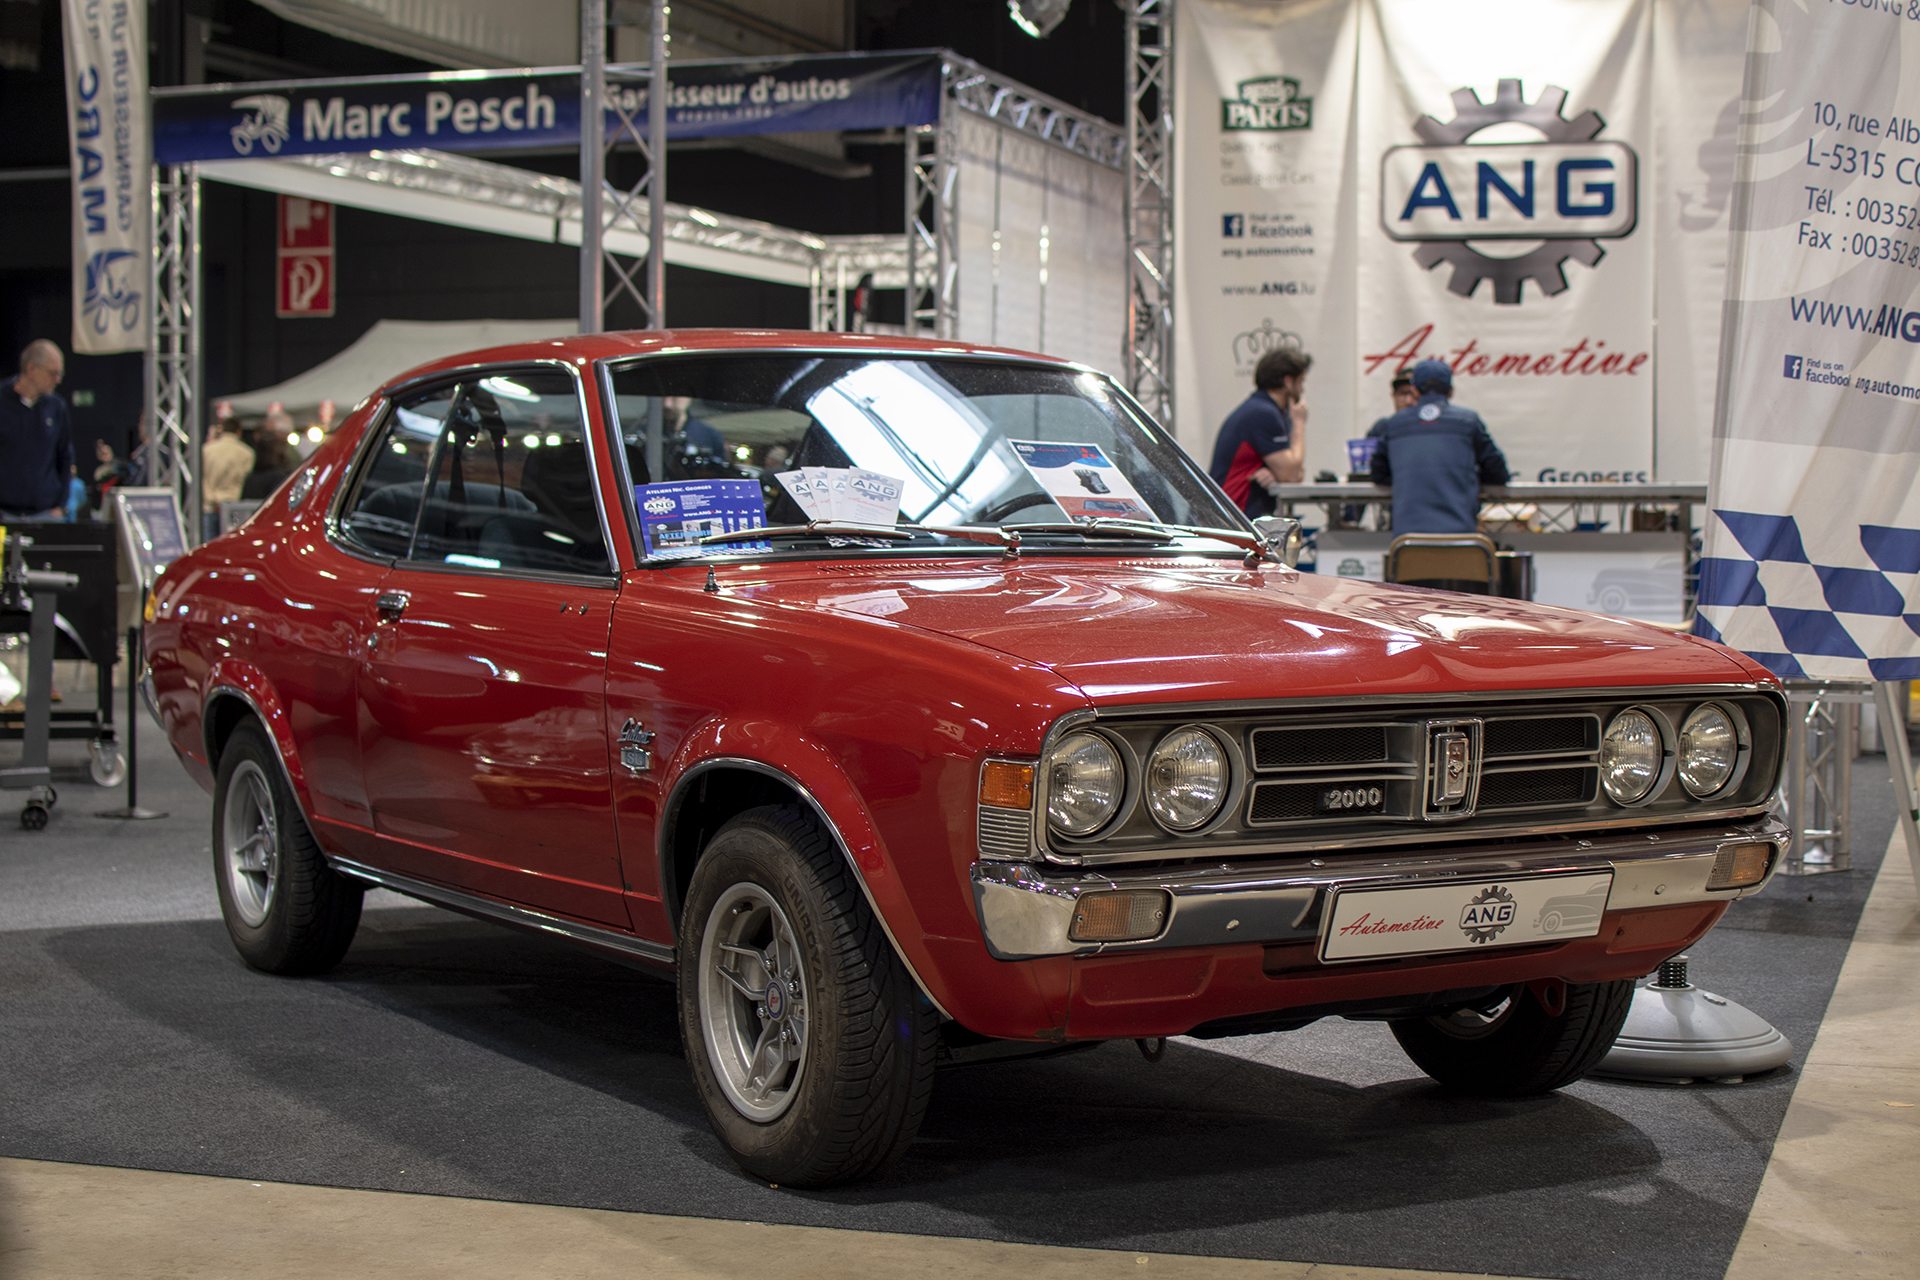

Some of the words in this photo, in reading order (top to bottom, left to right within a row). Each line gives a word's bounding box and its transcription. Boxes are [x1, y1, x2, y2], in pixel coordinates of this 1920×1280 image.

[602, 81, 746, 110] Garisseur
[749, 76, 851, 104] d'autos
[303, 97, 411, 141] Marc
[425, 83, 555, 134] Pesch
[1227, 103, 1309, 127] PARTS
[1814, 102, 1841, 131] 10,
[1848, 113, 1880, 136] rue
[1807, 138, 1886, 178] L-5315
[1398, 159, 1615, 220] ANG
[1805, 186, 1836, 215] Tél.
[1857, 197, 1920, 231] 00352
[1798, 222, 1832, 250] Fax
[1362, 323, 1649, 377] Atomotive
[1806, 358, 1821, 369] Find
[1823, 362, 1832, 370] us
[1834, 363, 1844, 371] on
[853, 479, 895, 496] ANG
[646, 501, 674, 510] ANG
[658, 529, 712, 540] AFTERWORK
[1329, 787, 1381, 809] 2000
[1339, 912, 1445, 937] Automotive
[1463, 905, 1513, 924] ANG
[784, 876, 825, 1002] UNIROYAL
